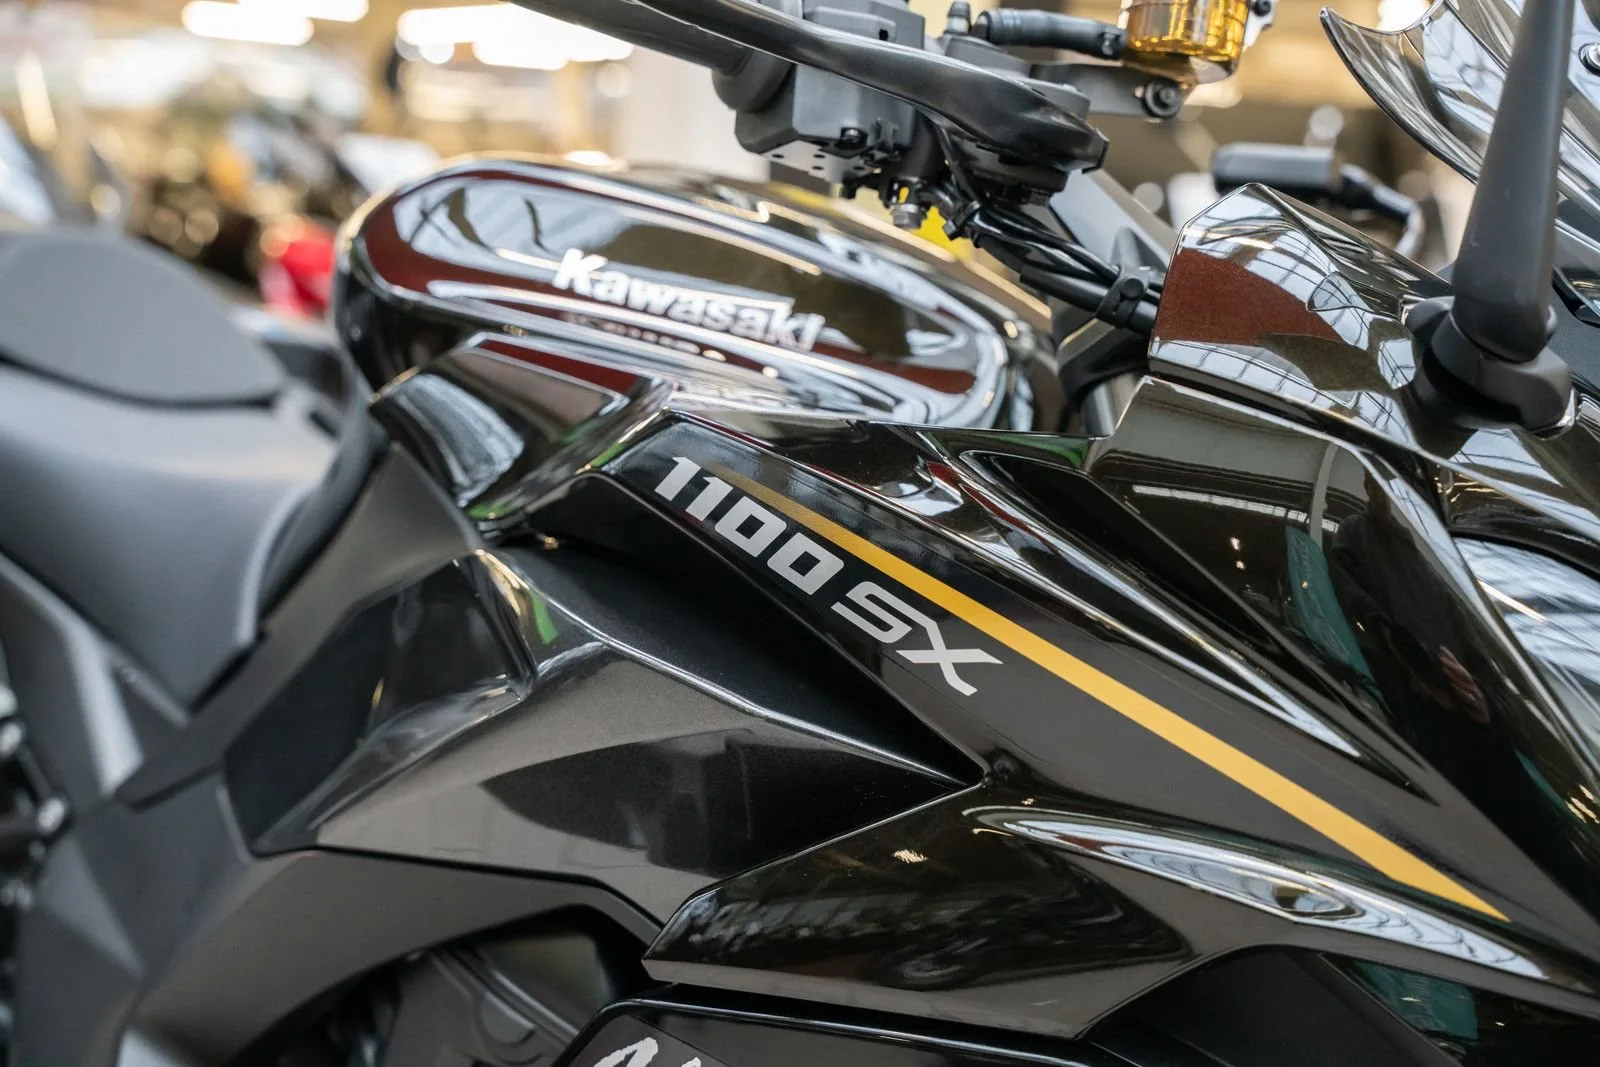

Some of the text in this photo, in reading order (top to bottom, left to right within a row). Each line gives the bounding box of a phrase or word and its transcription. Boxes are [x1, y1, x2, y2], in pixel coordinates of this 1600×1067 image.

[552, 248, 825, 351] Kawasaki
[655, 457, 1003, 696] 1100 SX
